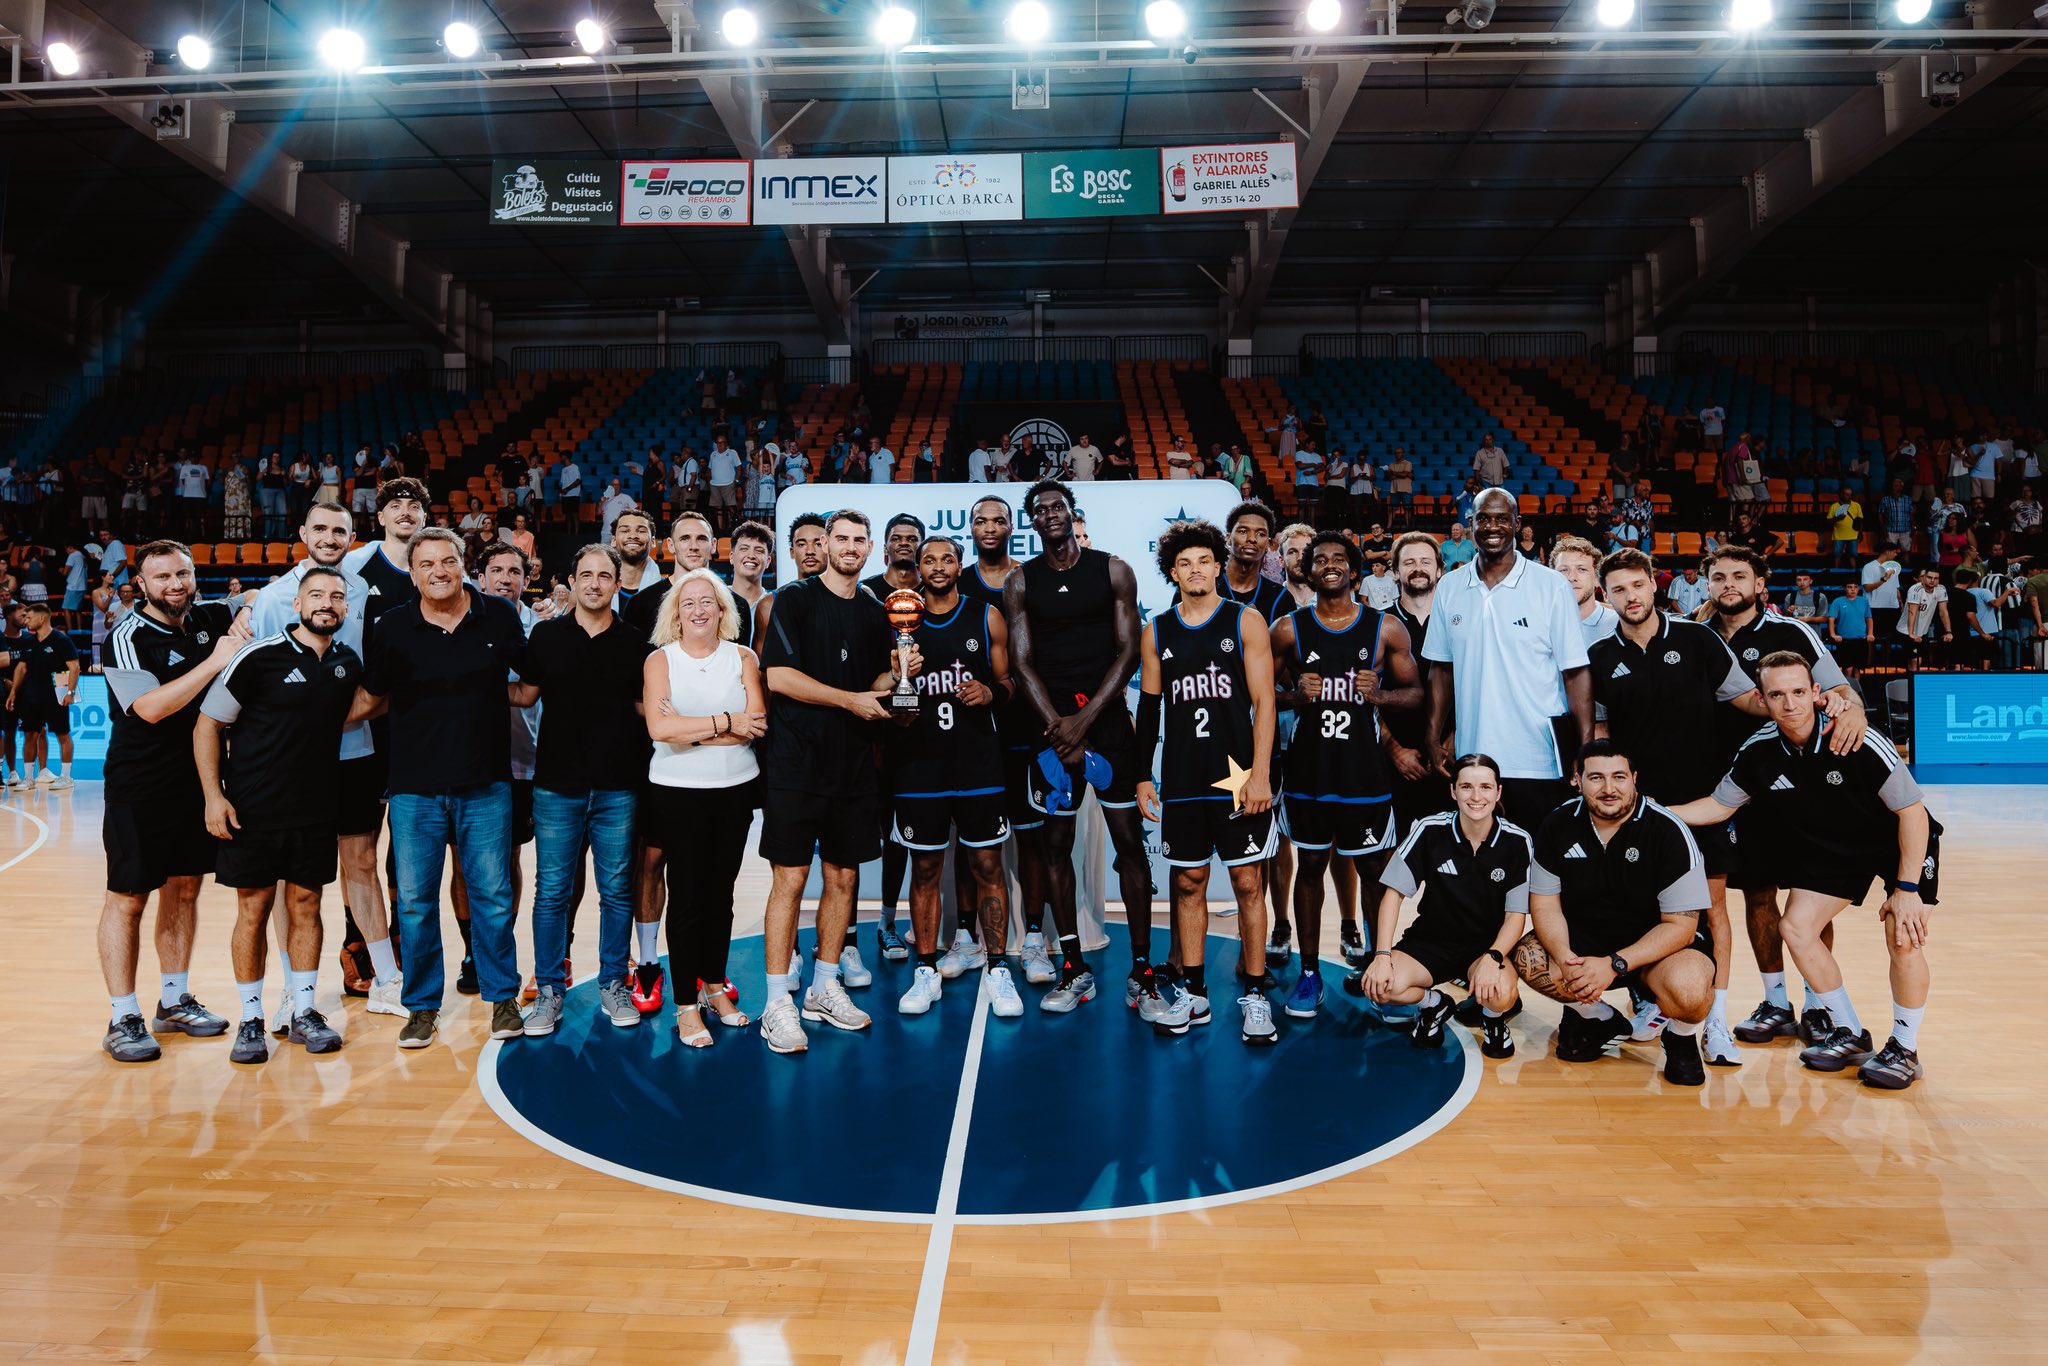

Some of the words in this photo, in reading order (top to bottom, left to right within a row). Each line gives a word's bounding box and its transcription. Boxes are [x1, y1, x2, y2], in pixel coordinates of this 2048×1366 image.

[1192, 151, 1269, 164] EXTINTORES
[1194, 166, 1203, 177] Y
[1206, 163, 1267, 176] ALARMAS
[566, 173, 601, 183] Cultiu
[1193, 180, 1237, 191] GABRIEL
[1240, 177, 1270, 189] ALLÉS
[564, 187, 602, 197] Visites
[644, 180, 746, 196] SIROCO
[503, 188, 546, 211] Bolets
[896, 193, 956, 207] ÓPTICA
[963, 193, 1014, 205] BARCA
[1201, 196, 1218, 205] 971
[1220, 195, 1232, 204] 35
[1235, 195, 1246, 203] 14
[1248, 194, 1261, 203] 20
[551, 200, 614, 214] Degustació
[922, 314, 959, 327] JORDI
[961, 315, 1009, 327] OLVERA
[1171, 661, 1232, 705] PARIS
[937, 702, 954, 731] 9
[1194, 707, 1211, 738] 2
[1321, 709, 1351, 740] 32
